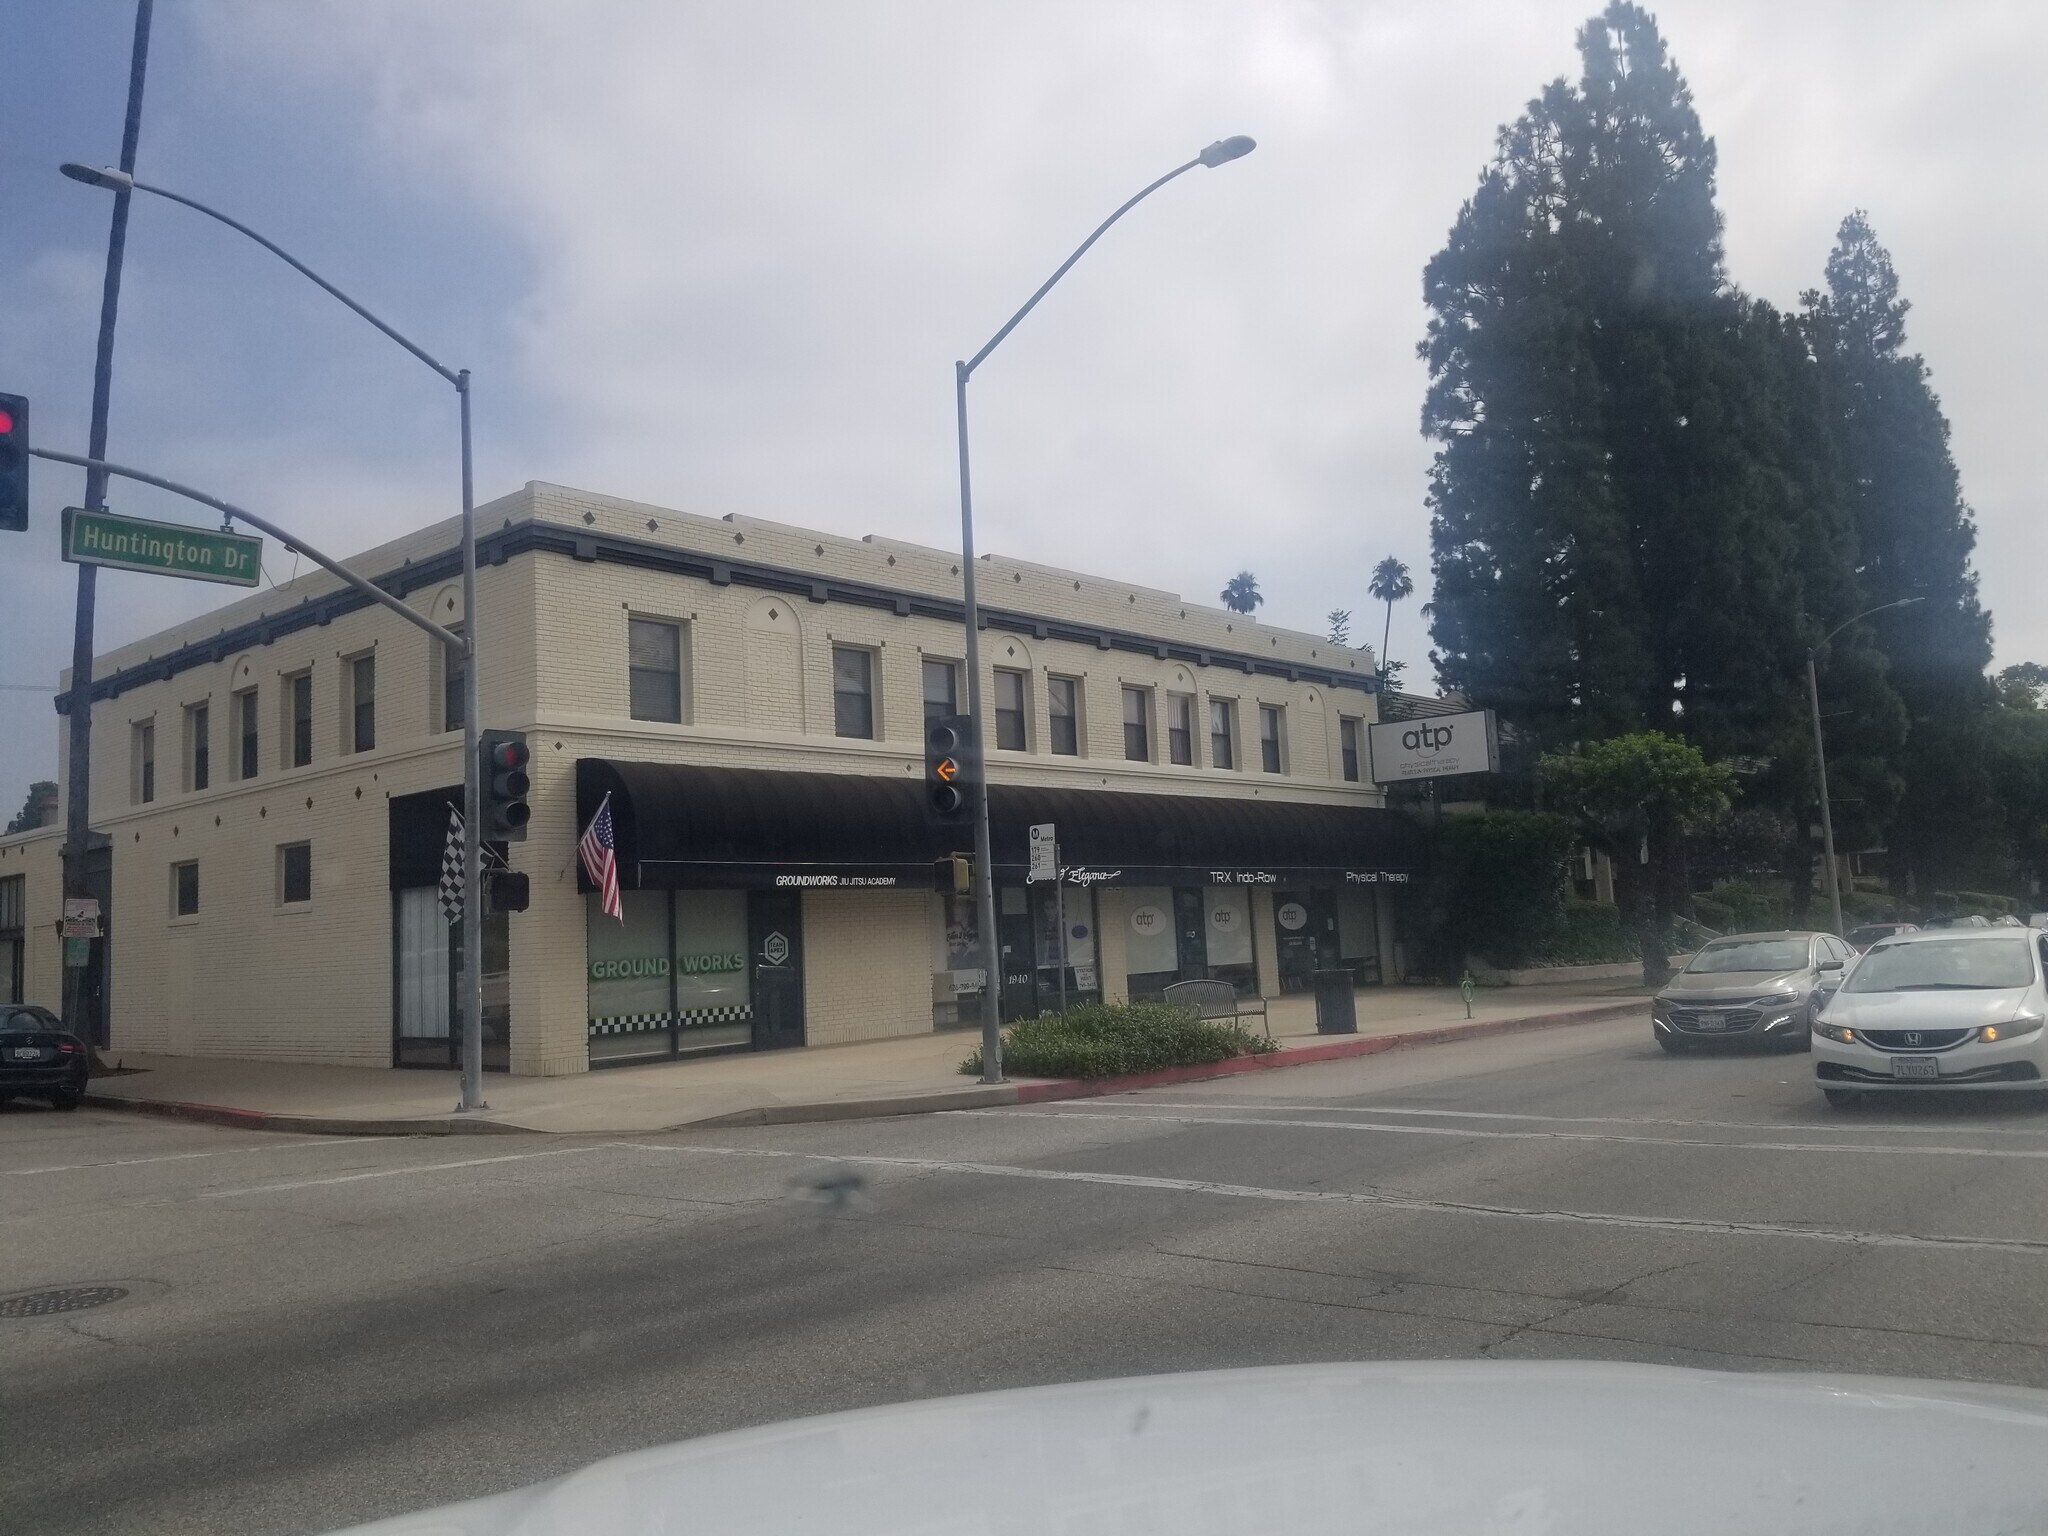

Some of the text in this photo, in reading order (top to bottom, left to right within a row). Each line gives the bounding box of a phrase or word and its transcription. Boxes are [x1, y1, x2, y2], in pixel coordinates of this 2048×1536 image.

[83, 525, 249, 570] Huntington Dr
[1402, 722, 1453, 751] atp
[1031, 846, 1041, 855] 179
[1031, 854, 1041, 862] 260
[1031, 862, 1041, 870] 261
[776, 875, 896, 886] GROUNDWORKS JIU JITSU ACADEMY
[1068, 866, 1121, 887] Elegance
[1210, 871, 1277, 883] TRX Indo-Row
[1346, 871, 1409, 885] Physical Therapy
[1136, 911, 1154, 927] atp
[1215, 908, 1231, 925] atp
[592, 953, 745, 979] GROUND WORKS
[1008, 974, 1028, 985] 1940
